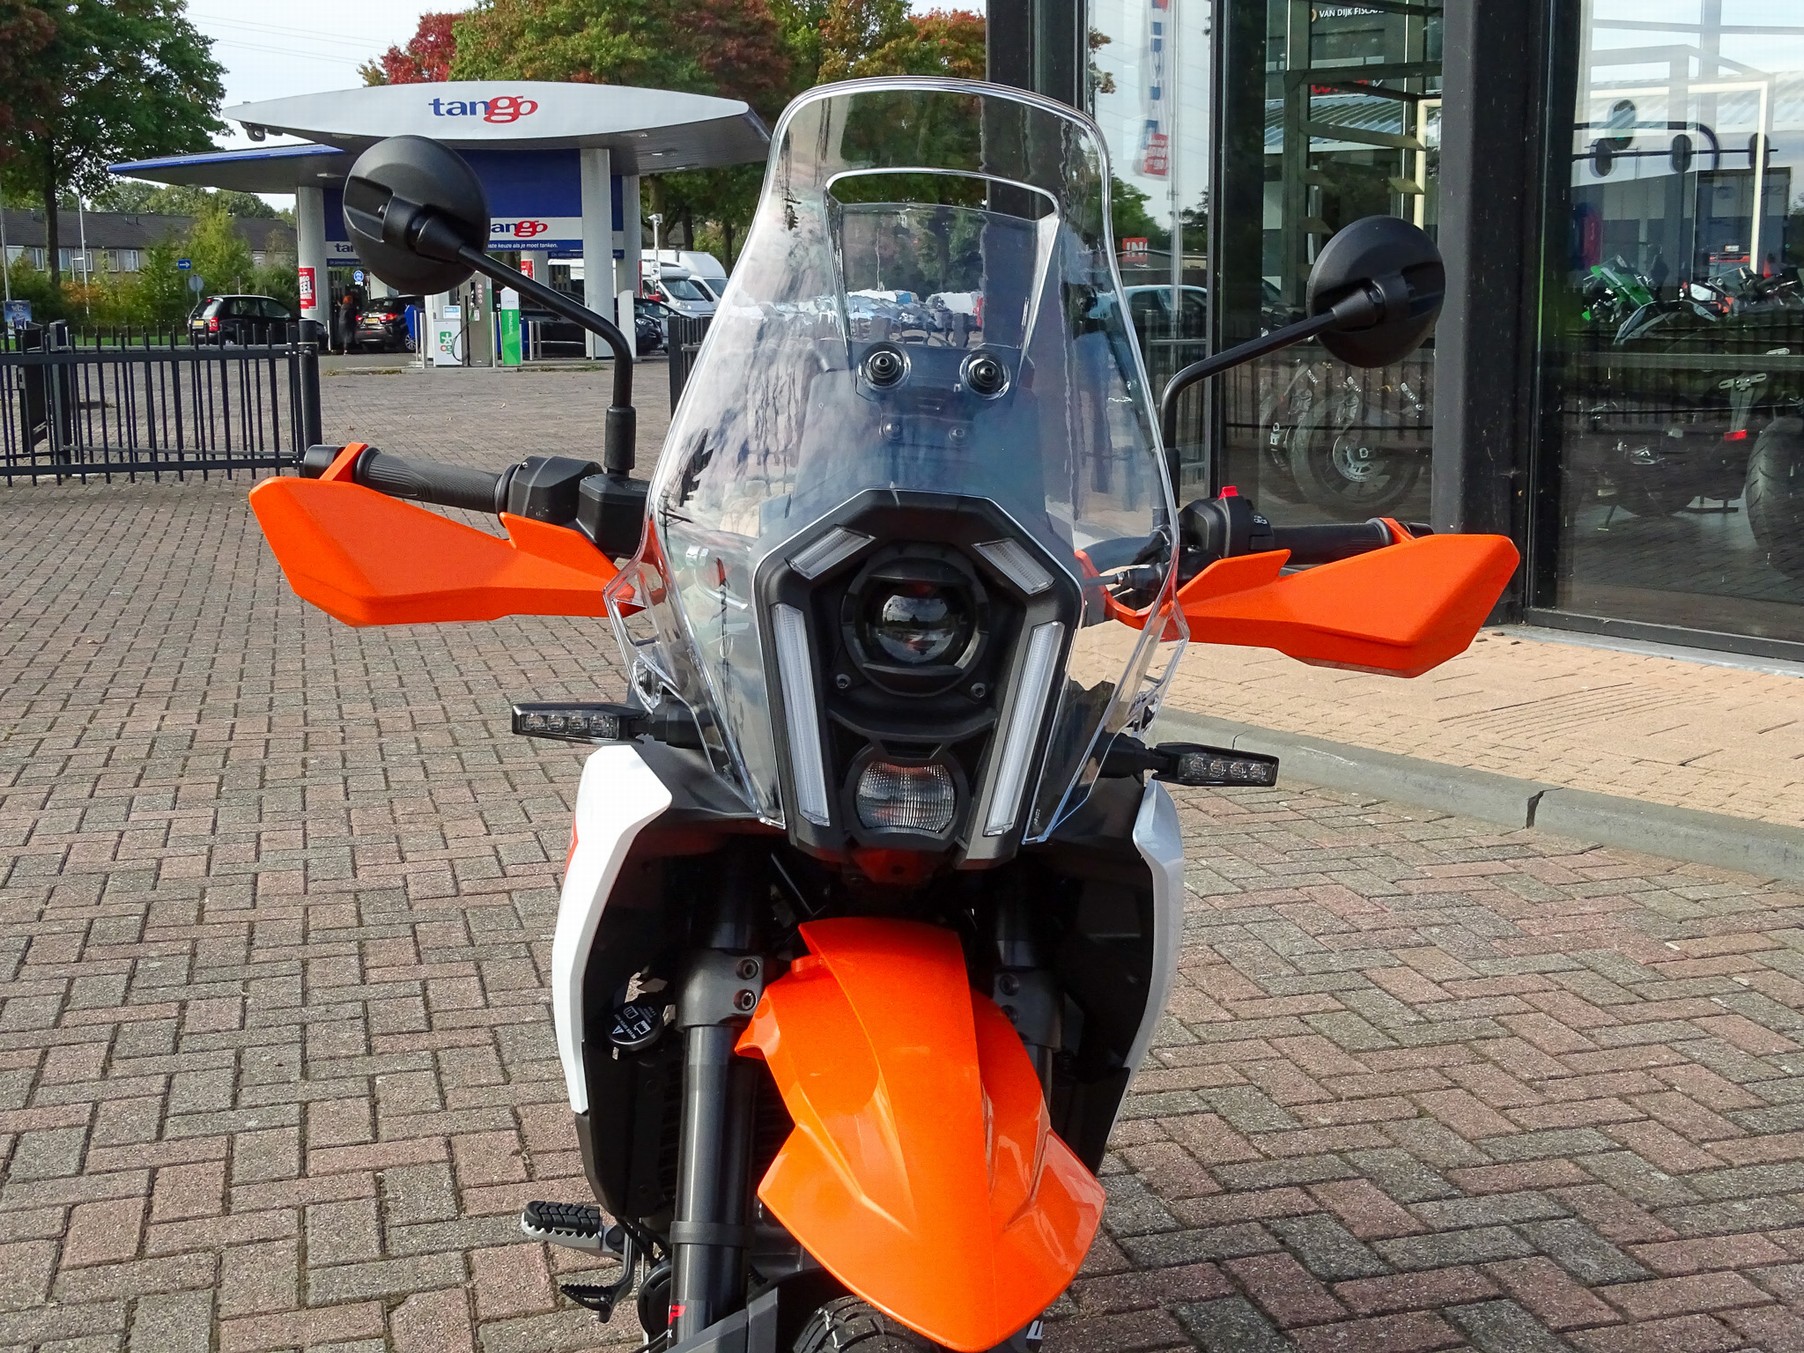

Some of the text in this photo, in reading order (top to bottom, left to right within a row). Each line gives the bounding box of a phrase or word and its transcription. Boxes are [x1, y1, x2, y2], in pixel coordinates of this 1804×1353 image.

[1319, 9, 1335, 18] VAN
[1337, 8, 1353, 17] DIJK
[428, 96, 538, 123] tango
[490, 220, 548, 238] ango
[1126, 241, 1148, 258] IN
